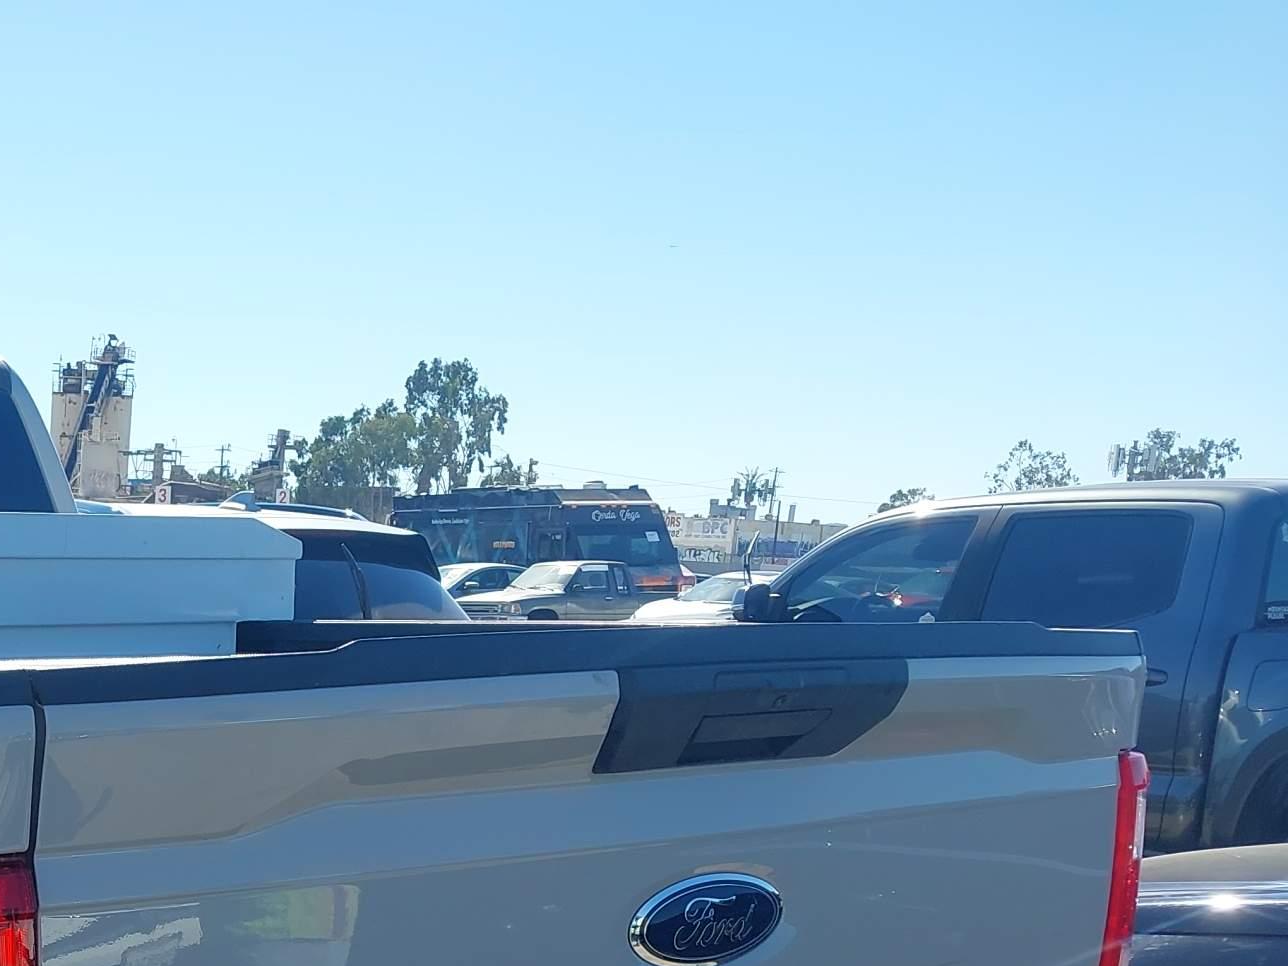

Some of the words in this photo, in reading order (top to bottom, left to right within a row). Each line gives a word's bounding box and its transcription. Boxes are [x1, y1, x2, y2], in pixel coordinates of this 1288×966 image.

[158, 488, 166, 503] 3
[278, 492, 286, 503] 2
[665, 516, 682, 528] ORS
[673, 895, 758, 951] Ford
